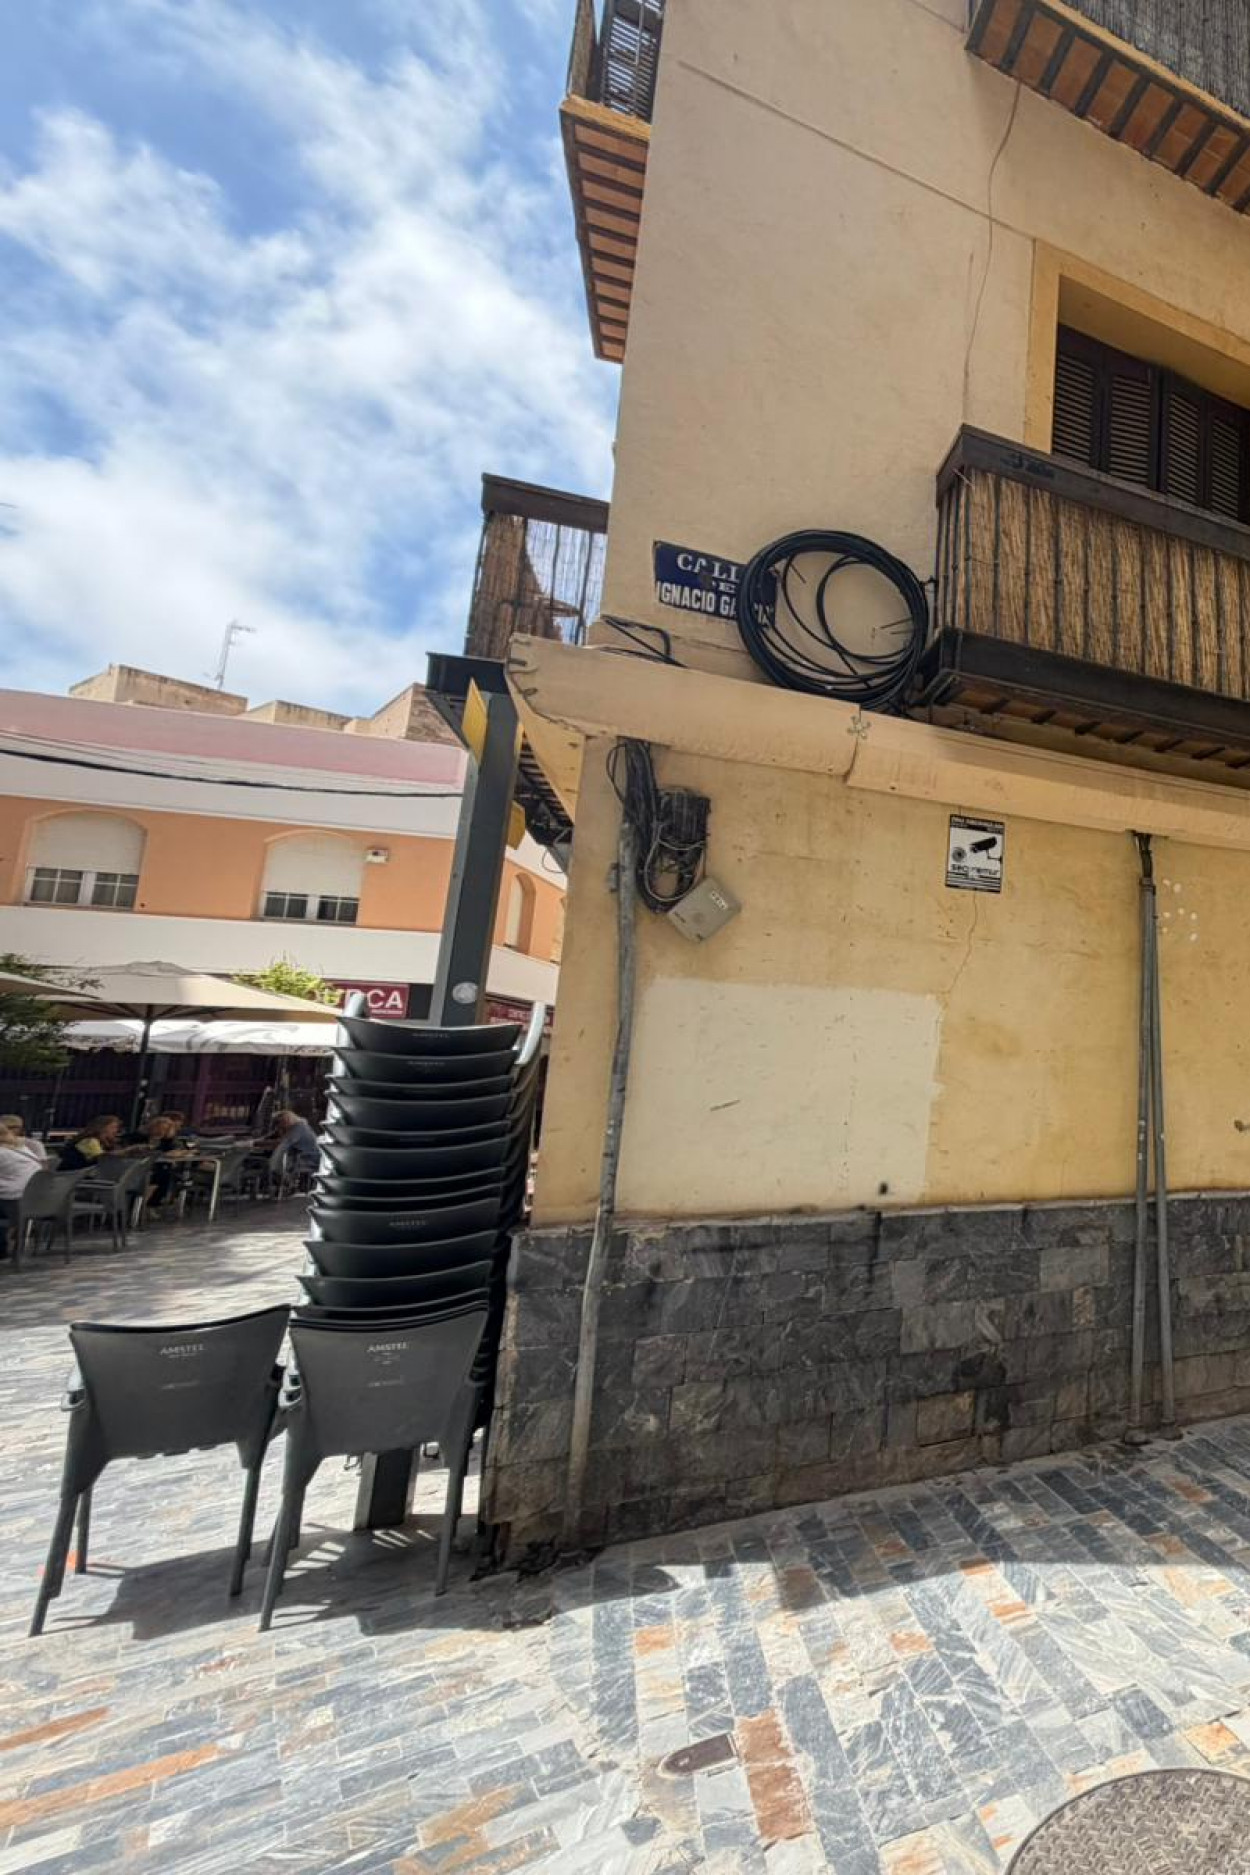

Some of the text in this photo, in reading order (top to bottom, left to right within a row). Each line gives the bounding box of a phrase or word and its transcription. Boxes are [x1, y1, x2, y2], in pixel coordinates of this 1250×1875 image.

[656, 580, 716, 613] IGNACIO
[158, 1343, 207, 1355] AMSTEL
[366, 1341, 409, 1352] AMSTEL
